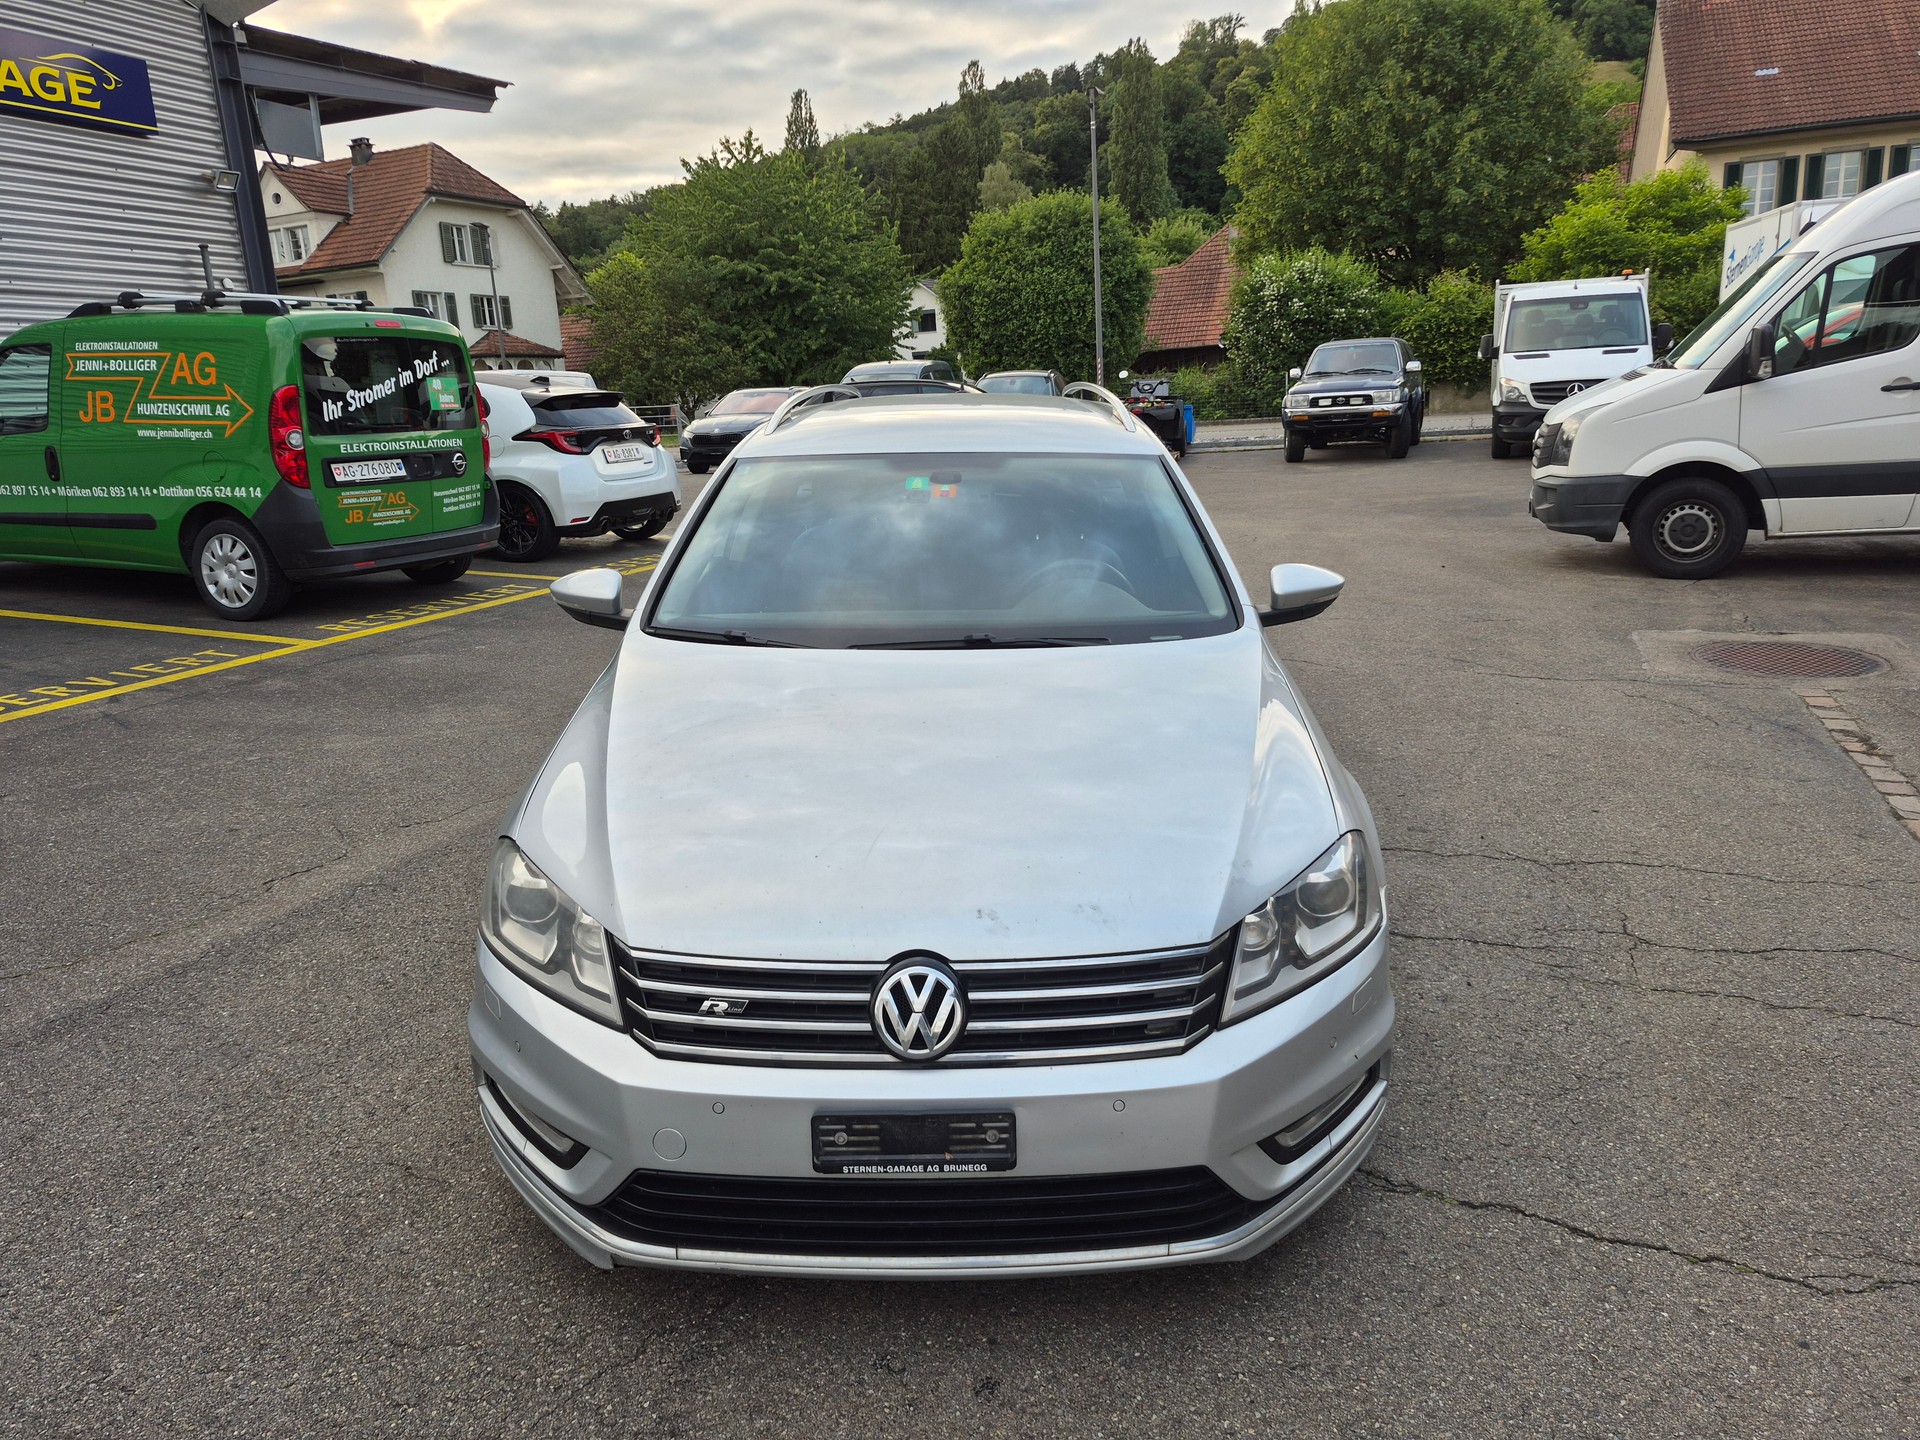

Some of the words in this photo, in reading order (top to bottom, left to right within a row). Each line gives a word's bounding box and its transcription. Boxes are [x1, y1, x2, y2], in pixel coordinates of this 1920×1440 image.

[0, 58, 102, 110] AGE
[75, 341, 158, 351] ELEKTROINSTALLATIONEN
[75, 359, 157, 372] JENNI+BOLLIGER
[171, 352, 217, 386] AG
[322, 398, 343, 423] Ihr
[346, 376, 397, 412] Stromer
[397, 367, 414, 388] im
[413, 350, 438, 380] Dorf
[79, 390, 116, 423] JB
[137, 403, 213, 416] HUNZENSCHWIL
[215, 403, 230, 416] AG
[137, 428, 213, 440] www.jennibolliger.ch
[340, 438, 463, 453] ELEKTROINSTALLATIONEN
[0, 485, 11, 495] 62
[11, 485, 26, 496] 897
[28, 485, 39, 496] 15
[40, 485, 50, 496] 14
[57, 486, 92, 497] Möriken
[92, 486, 109, 497] 062
[109, 486, 126, 497] 893
[127, 486, 138, 497] 14
[140, 486, 151, 497] 14
[159, 485, 195, 497] Dottikon
[195, 486, 213, 497] 056
[214, 486, 232, 498] 624
[233, 486, 247, 498] 44
[249, 486, 262, 498] 14
[387, 491, 406, 505] AG
[345, 509, 364, 524] JB
[315, 583, 537, 632] RESERVIERT
[0, 649, 239, 712] ERVIERT
[842, 1165, 925, 1174] STERNEN-GARAGE
[926, 1164, 940, 1173] AG
[943, 1163, 988, 1173] BRUNEGG
